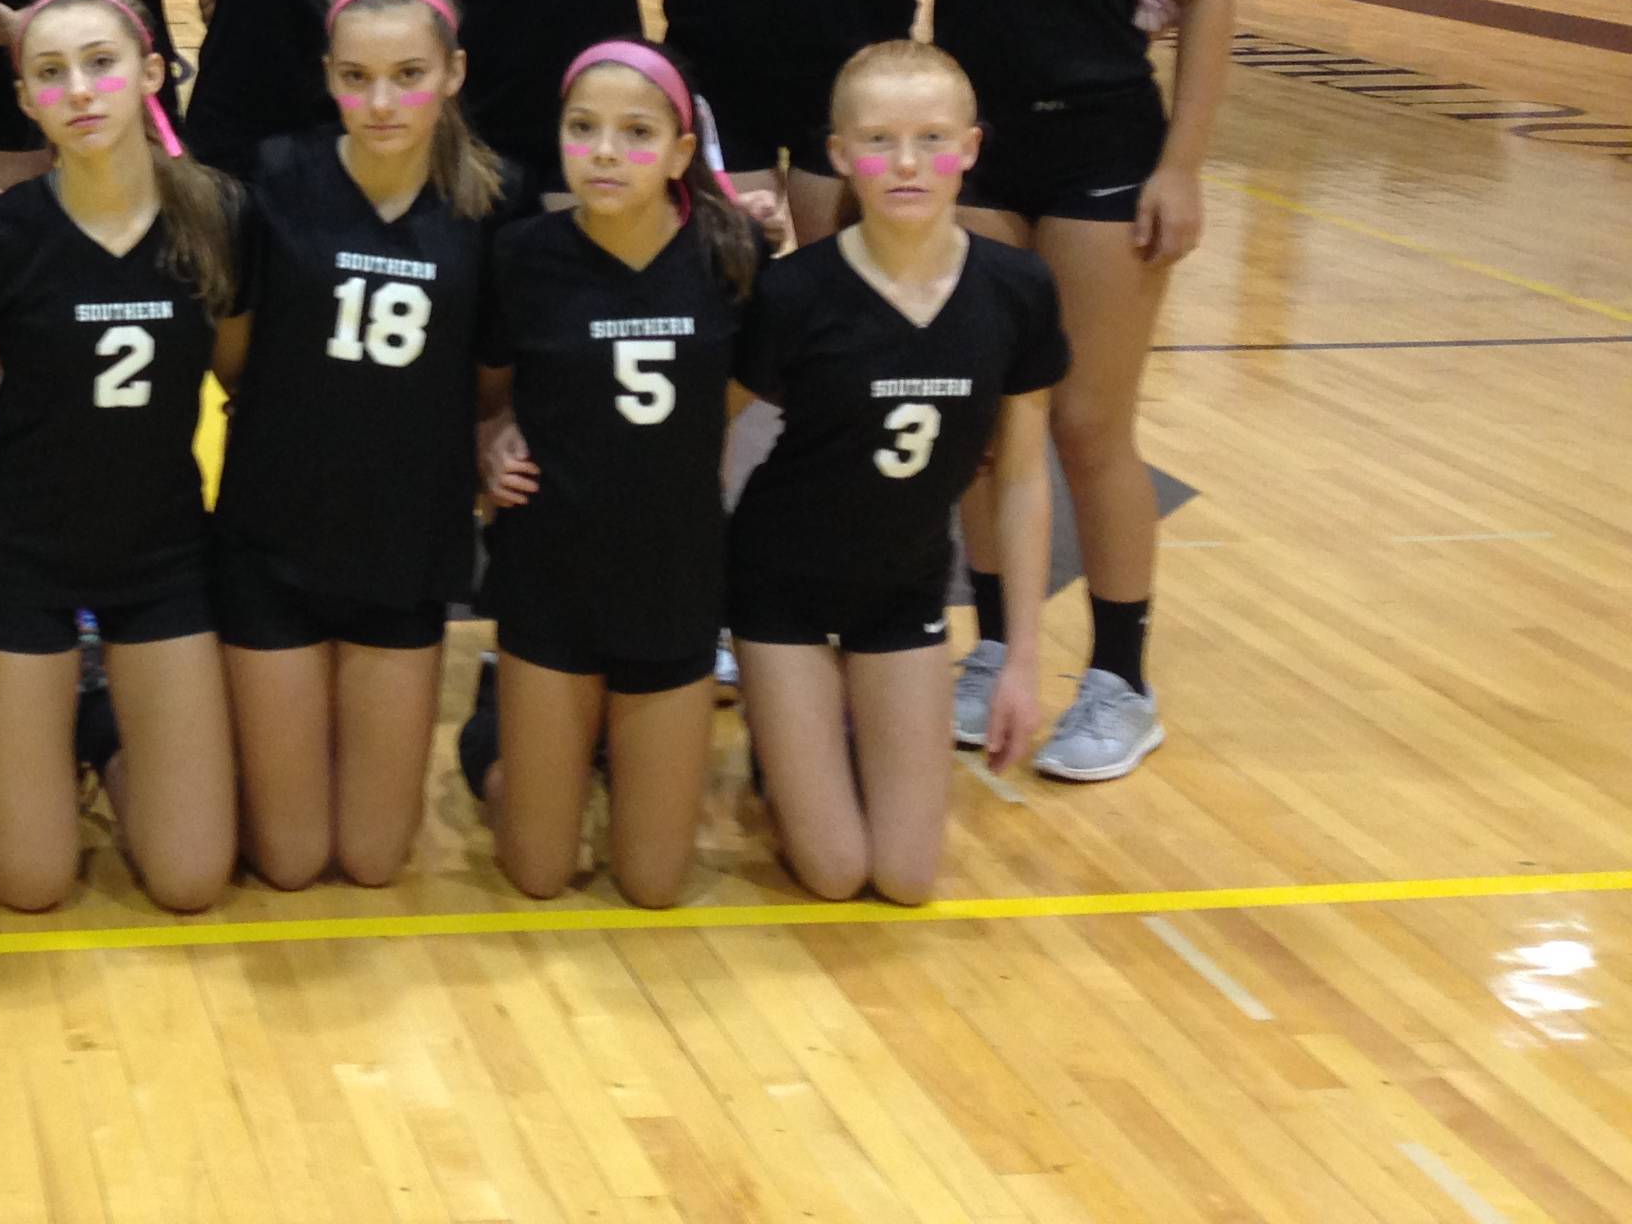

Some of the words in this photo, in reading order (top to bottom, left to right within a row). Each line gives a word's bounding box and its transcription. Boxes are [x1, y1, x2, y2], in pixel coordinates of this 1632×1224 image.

[335, 252, 438, 279] SOUTHERN
[75, 301, 174, 322] SOUTHERN
[327, 277, 432, 368] 18
[590, 316, 696, 338] SOUTHERN
[94, 325, 155, 408] 2
[613, 340, 676, 425] 5
[871, 378, 973, 397] SOUTHERN
[873, 403, 941, 479] 3
